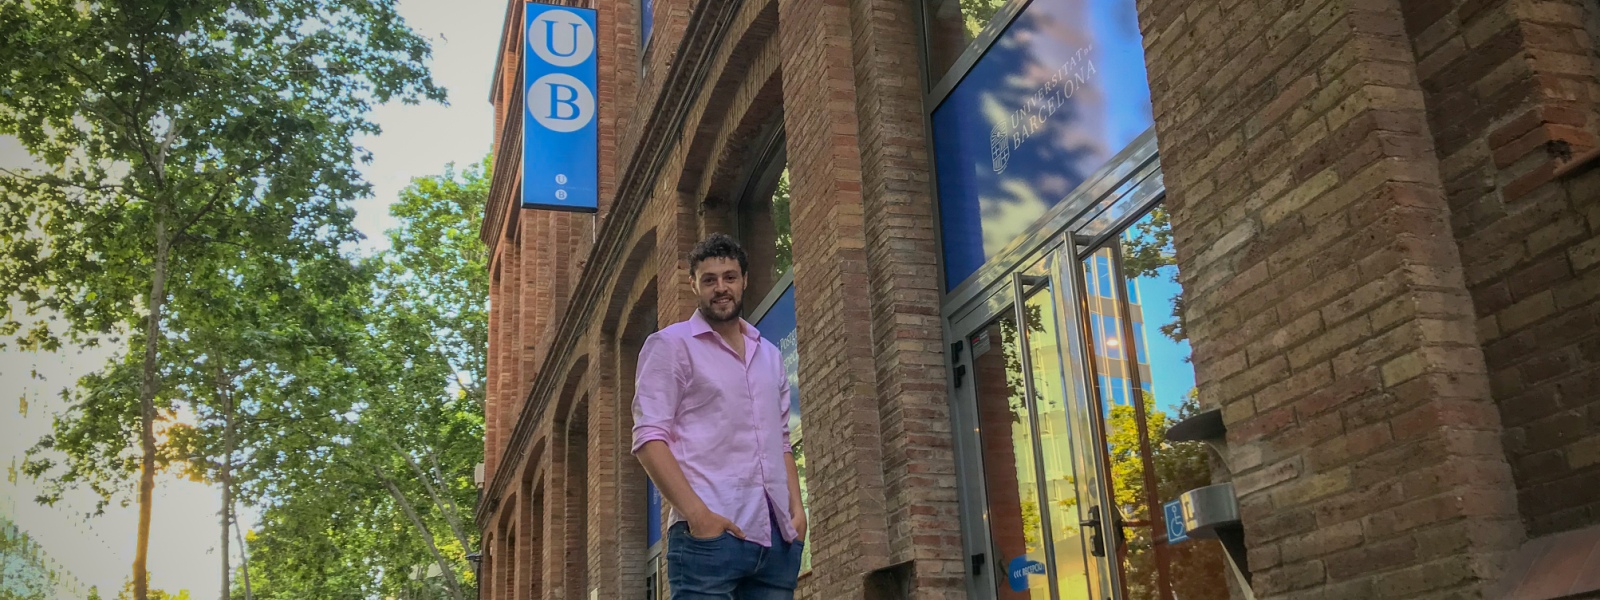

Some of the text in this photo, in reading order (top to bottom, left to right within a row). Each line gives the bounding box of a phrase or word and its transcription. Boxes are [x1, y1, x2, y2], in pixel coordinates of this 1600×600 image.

[541, 19, 582, 57] U
[544, 82, 580, 120] B
[1010, 47, 1083, 129] UNIVERSITAT
[1012, 59, 1096, 151] BARCELONA
